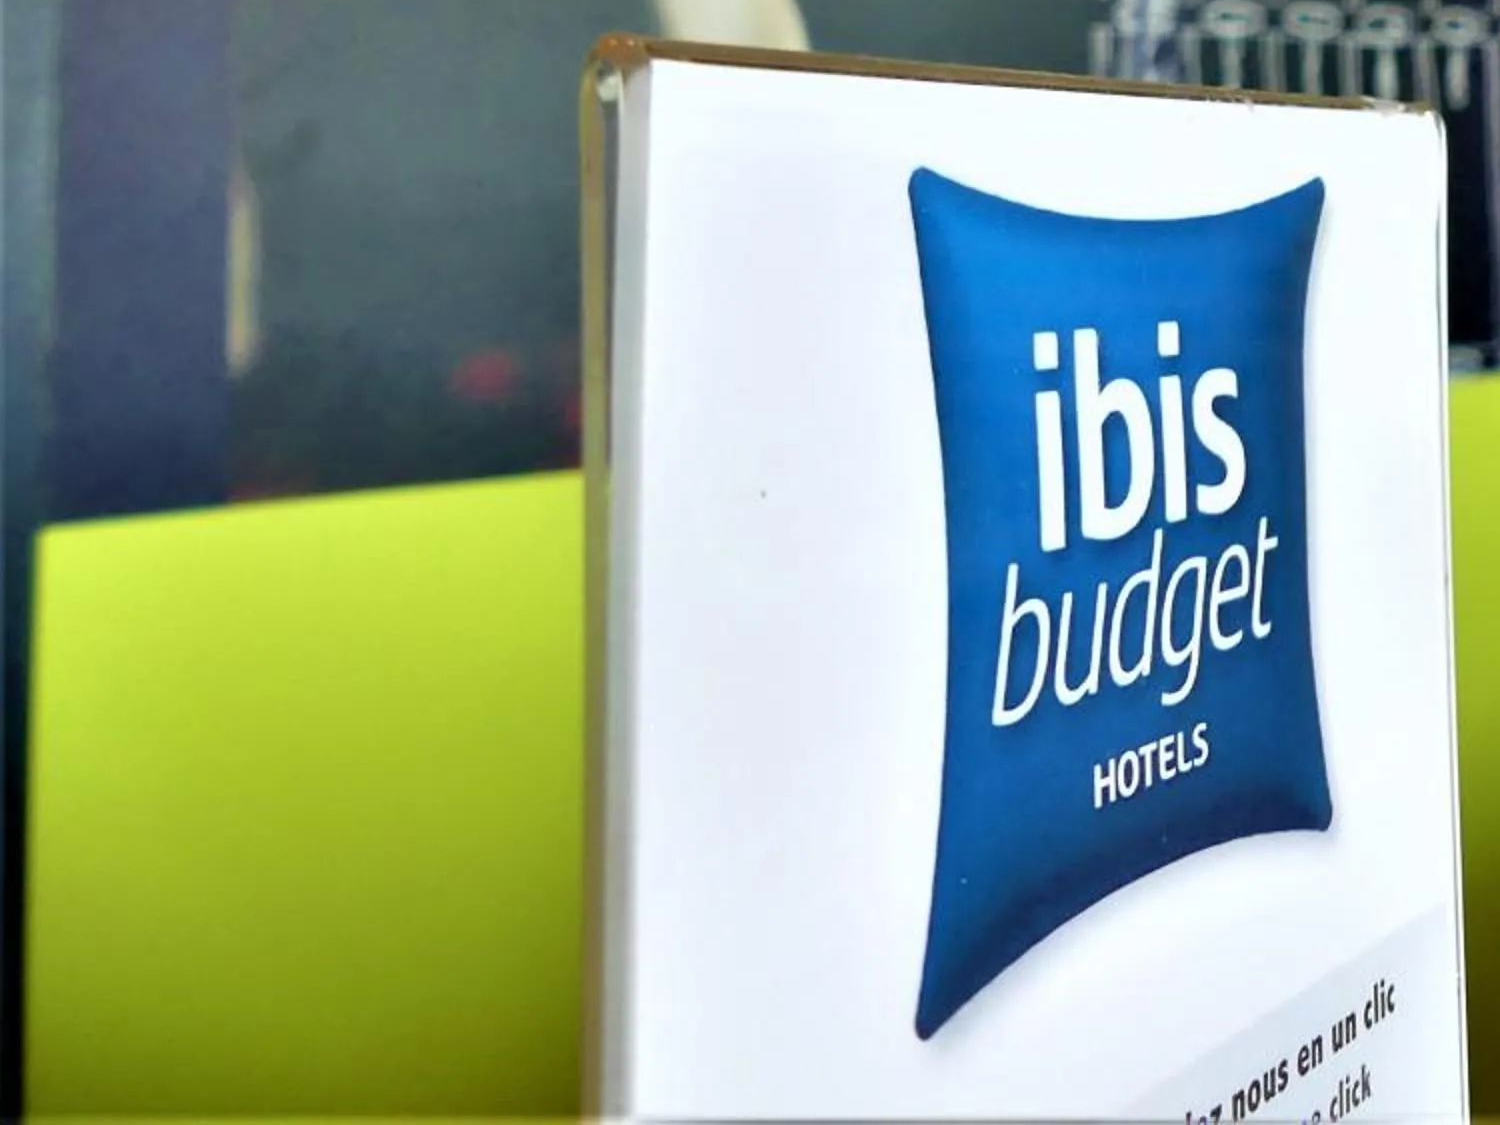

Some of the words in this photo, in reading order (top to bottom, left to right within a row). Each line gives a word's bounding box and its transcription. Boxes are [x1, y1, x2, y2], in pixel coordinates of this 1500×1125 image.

[1033, 321, 1246, 552] ibis
[991, 516, 1279, 726] budget
[1093, 723, 1209, 808] HOTELS
[1231, 1058, 1289, 1122] nous
[1297, 1034, 1323, 1077] en
[1331, 1012, 1357, 1053] un
[1363, 979, 1396, 1030] clic
[1330, 1064, 1372, 1123] click
